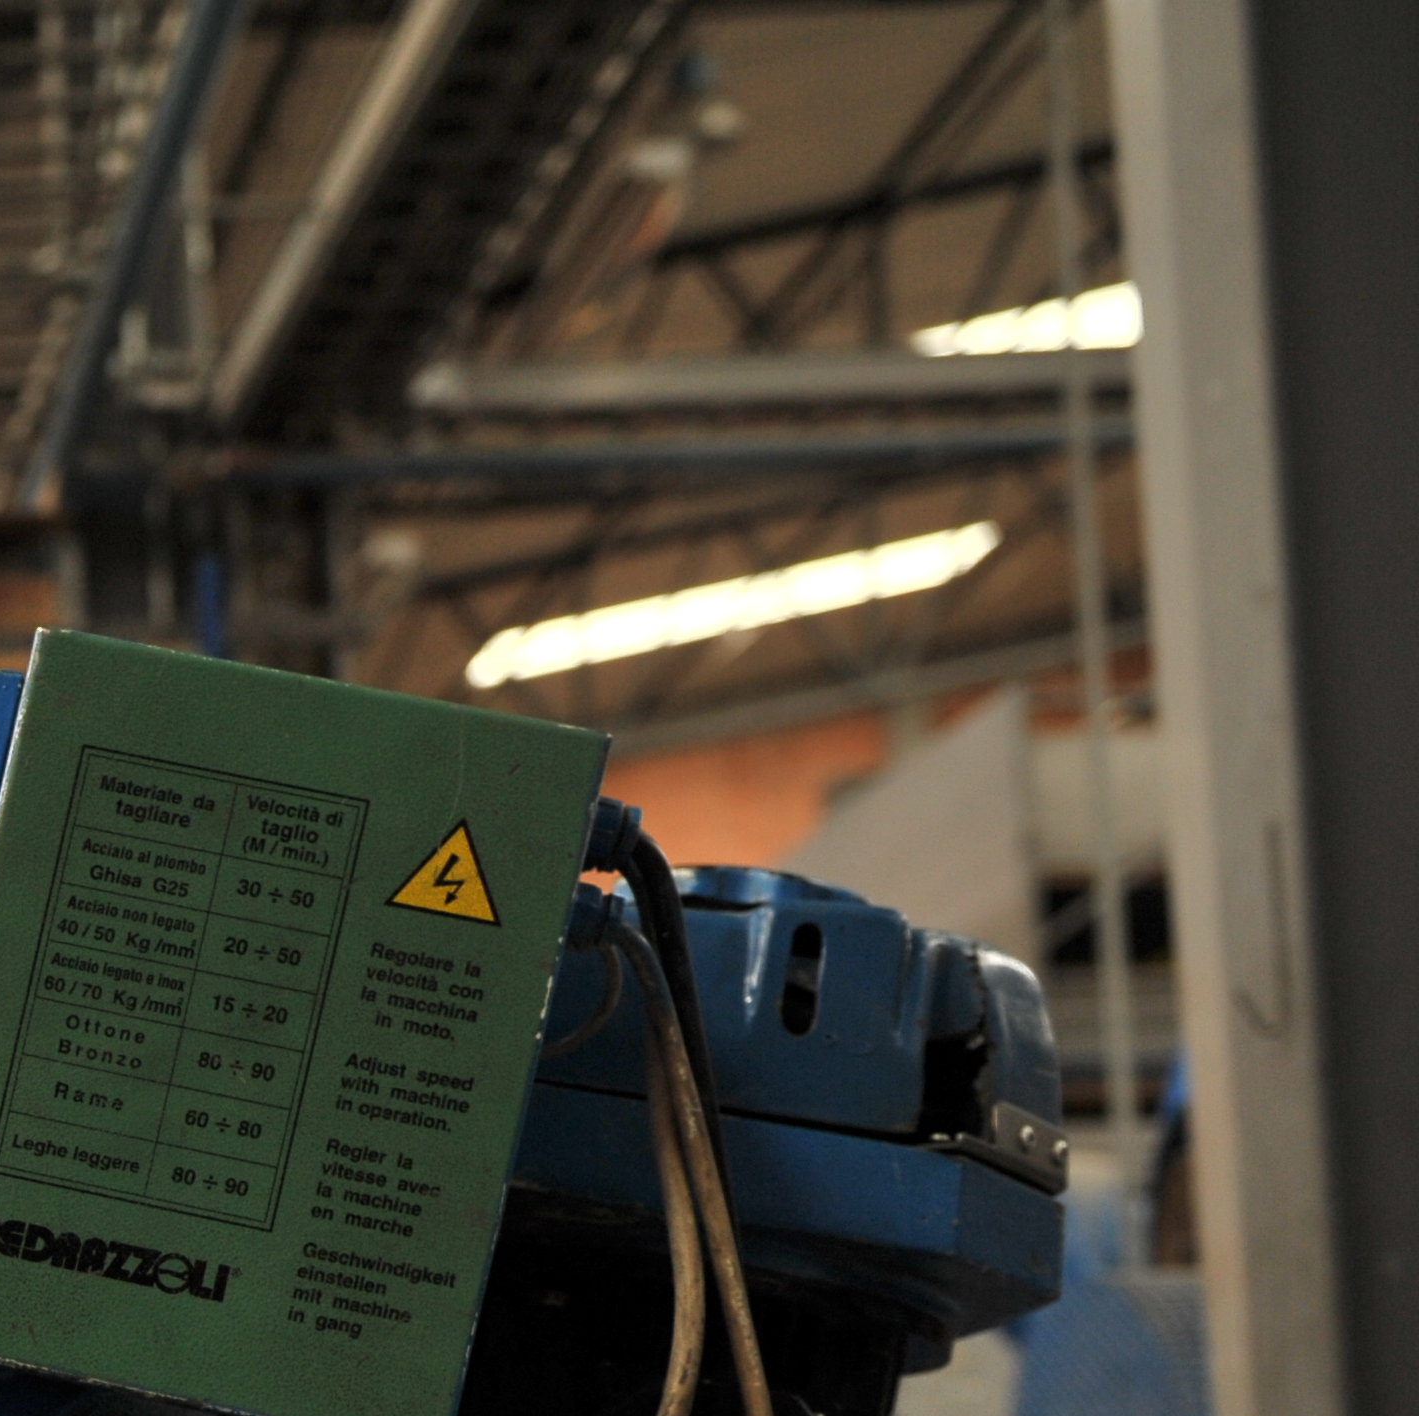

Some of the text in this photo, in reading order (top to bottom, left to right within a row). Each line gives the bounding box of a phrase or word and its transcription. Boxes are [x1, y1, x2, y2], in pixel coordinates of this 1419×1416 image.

[99, 775, 216, 812] Materiale da
[247, 794, 344, 828] Velocità di
[115, 798, 191, 829] tagliare
[261, 818, 320, 844] taglio
[81, 837, 207, 876] Acciaio al piombo
[89, 864, 190, 898] Ghisa G25
[66, 895, 196, 934] Acciaio non legato
[50, 951, 186, 992] Acciaio legato e inox
[370, 941, 482, 978] Regolare la
[366, 967, 484, 1002] velocità con
[359, 985, 479, 1023] la macchina
[65, 1014, 146, 1045] Ottone
[374, 1010, 455, 1042] in moto.
[57, 1037, 143, 1070] Bronzo
[344, 1052, 475, 1092] Adjust speed
[53, 1081, 124, 1112] Rame
[340, 1076, 470, 1114] with machine
[335, 1094, 452, 1133] in operation.
[11, 1133, 140, 1174] Leghe leggere
[325, 1138, 414, 1171] Regler la
[321, 1161, 441, 1197] vitesse avec
[315, 1180, 423, 1217] la machine
[310, 1205, 414, 1238] en marche
[296, 1265, 387, 1296] einstellen
[302, 1241, 457, 1289] Geschwindigkeit
[287, 1305, 363, 1340] in gang
[292, 1287, 412, 1324] mit machine
